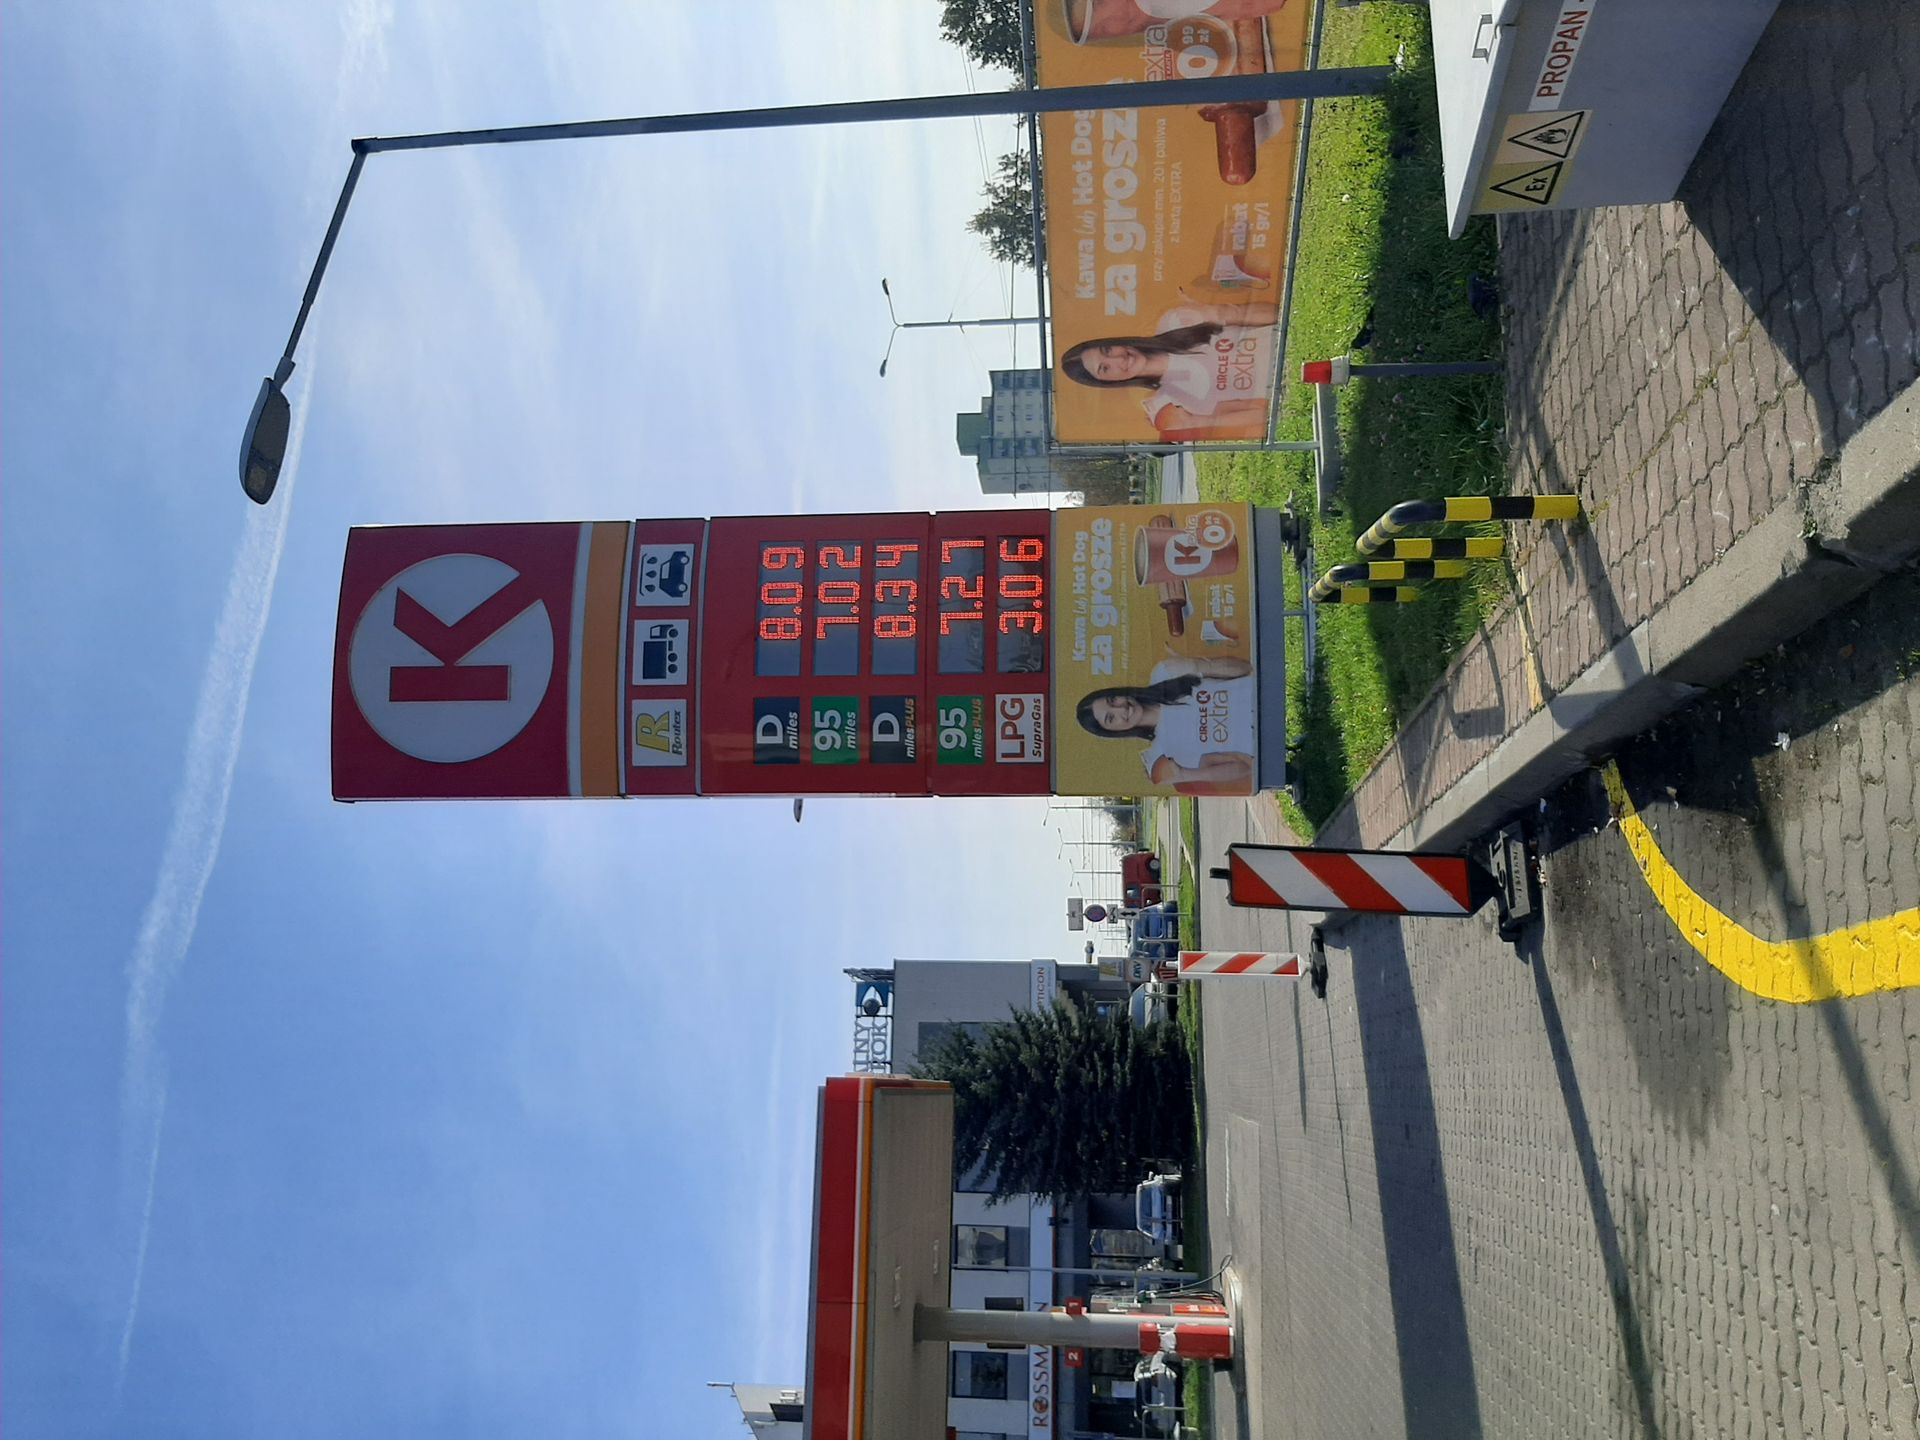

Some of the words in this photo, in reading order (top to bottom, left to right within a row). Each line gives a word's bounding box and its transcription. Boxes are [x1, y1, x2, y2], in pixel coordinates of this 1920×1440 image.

[1176, 45, 1218, 79] 0
[1536, 10, 1588, 97] PROPAN
[1072, 160, 1094, 205] Hot
[1102, 78, 1146, 253] grosz
[1154, 168, 1165, 182] 20
[1170, 160, 1182, 204] EXTRA
[1525, 178, 1548, 192] Ex
[1252, 234, 1266, 249] 15
[1075, 240, 1096, 298] Kawa
[1103, 264, 1137, 316] za
[1214, 339, 1234, 353] K
[1230, 338, 1257, 390] extra
[1216, 356, 1229, 390] CIRCLE
[1072, 531, 1088, 562] Dog
[1174, 540, 1200, 565] K
[1202, 525, 1225, 543] 0
[760, 546, 804, 640] 8.09
[817, 546, 861, 639] 7.02
[874, 544, 918, 638] 8.34
[940, 540, 984, 635] 7.27
[999, 539, 1044, 634] 3.06
[1072, 565, 1087, 594] Hot
[1090, 518, 1119, 628] grosze
[1072, 618, 1088, 662] Kawa
[1090, 635, 1113, 674] za
[1196, 690, 1210, 704] K
[1208, 690, 1228, 742] extra
[671, 710, 683, 756] Routex
[756, 714, 784, 744] D
[787, 712, 798, 749] miles
[815, 709, 842, 750] 95
[845, 712, 856, 748] miles
[872, 712, 900, 742] D
[904, 698, 916, 758] milesPLUS
[940, 707, 967, 749] 95
[972, 698, 983, 758] milesPLUS
[1000, 698, 1025, 758] LPG
[1032, 698, 1043, 758] SupraGas
[1199, 707, 1208, 742] CIRCLE
[1069, 1352, 1078, 1360] 2
